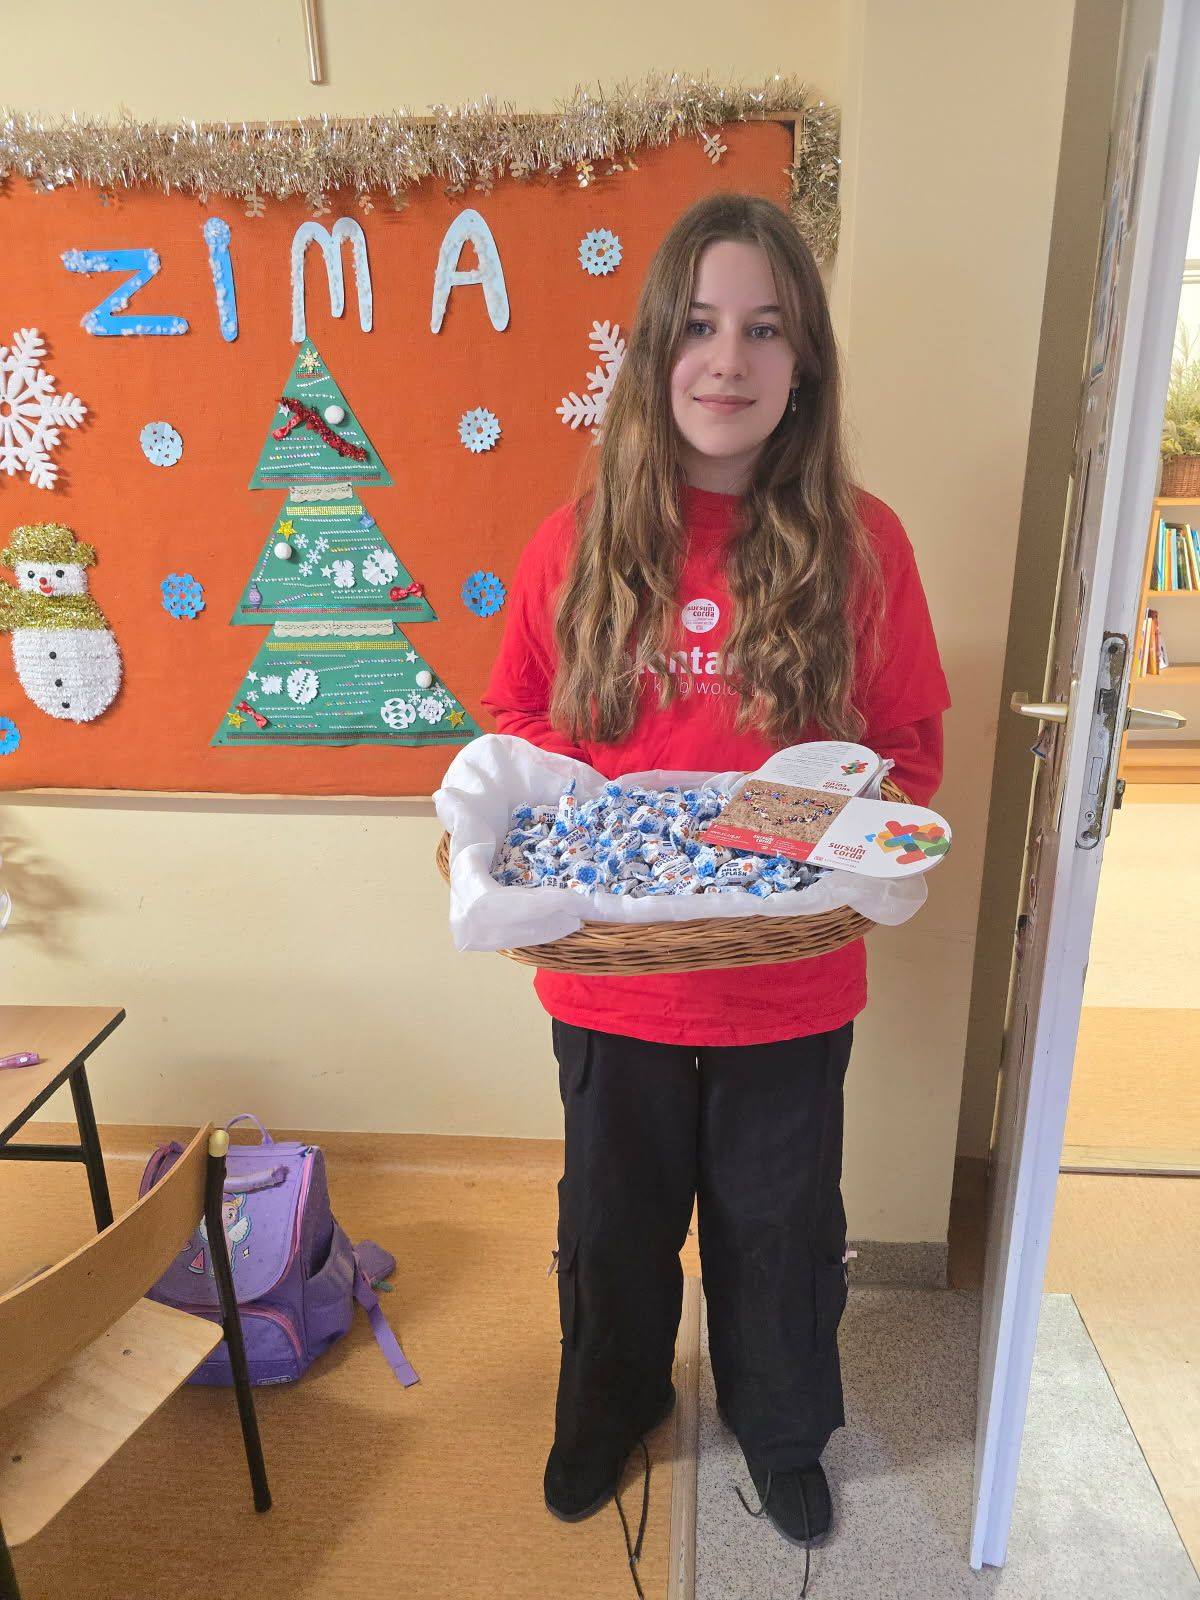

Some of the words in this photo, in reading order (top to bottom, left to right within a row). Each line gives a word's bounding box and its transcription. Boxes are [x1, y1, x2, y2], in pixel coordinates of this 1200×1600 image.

[60, 208, 510, 344] ZIMA
[692, 610, 715, 618] corda
[567, 833, 586, 846] SPLASH
[828, 842, 866, 855] sursum
[833, 849, 863, 860] corda
